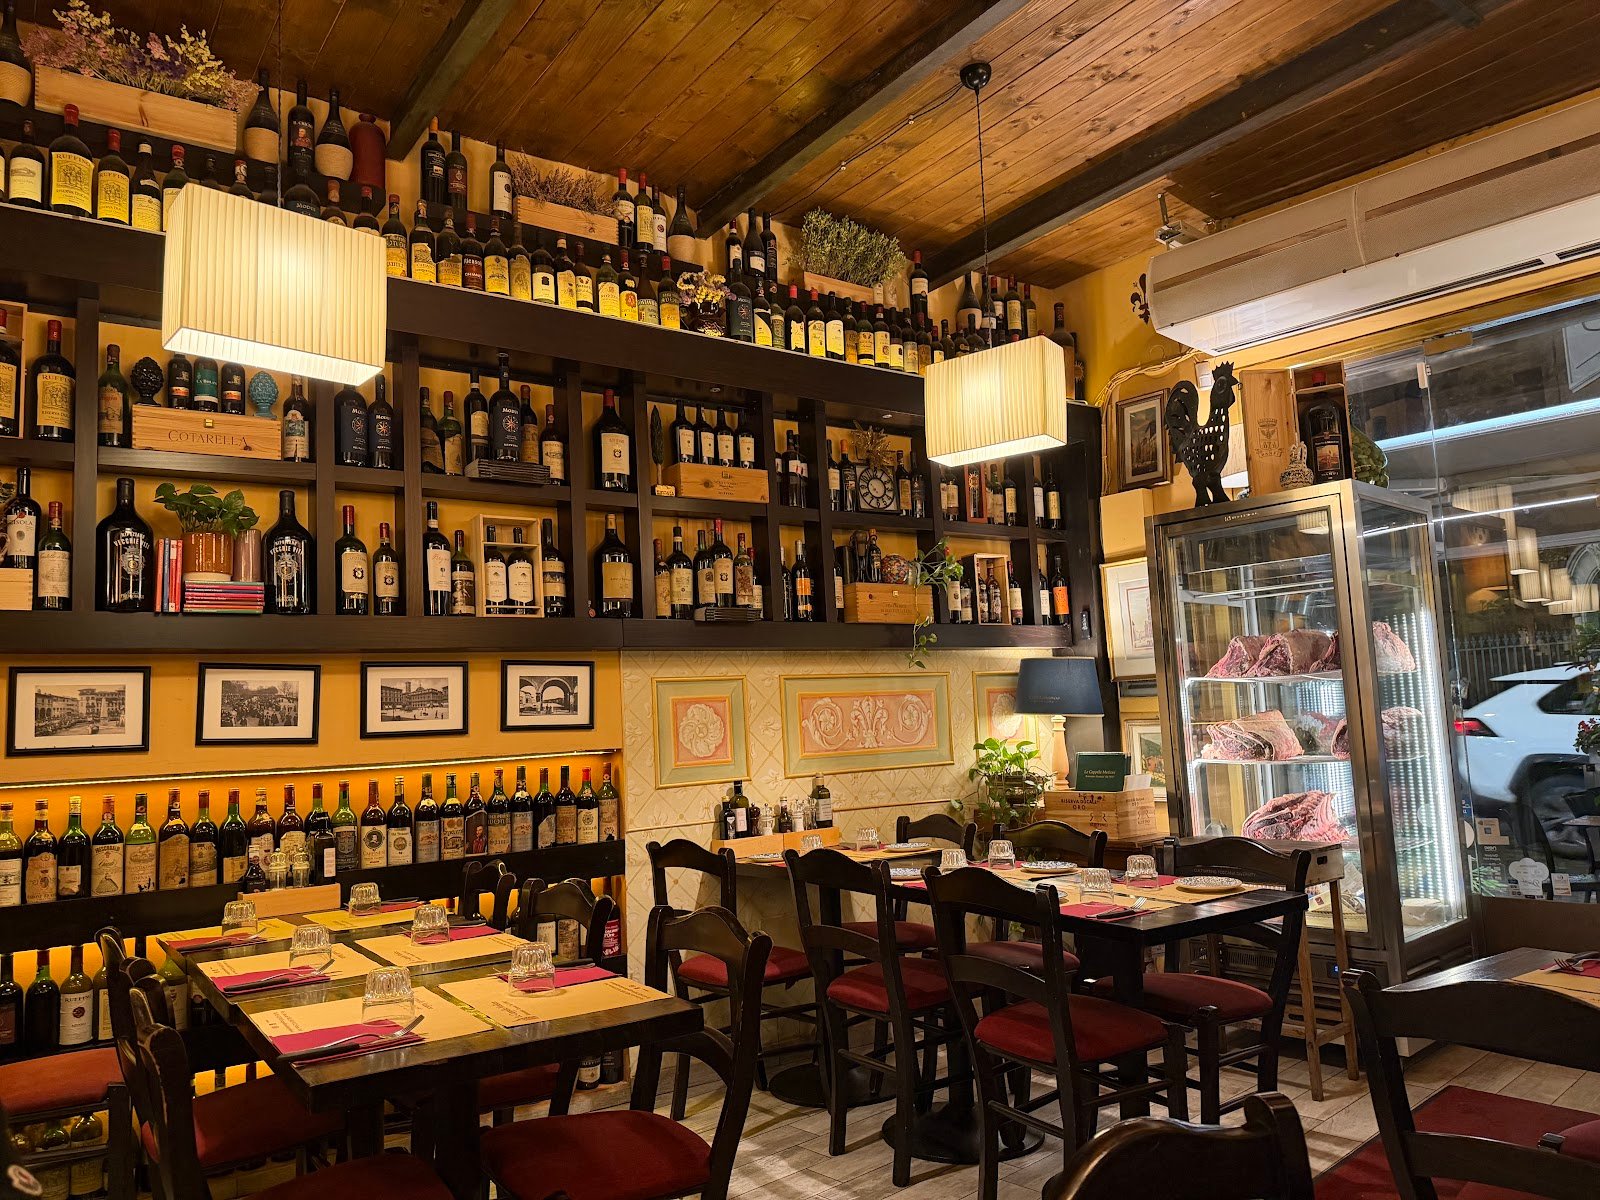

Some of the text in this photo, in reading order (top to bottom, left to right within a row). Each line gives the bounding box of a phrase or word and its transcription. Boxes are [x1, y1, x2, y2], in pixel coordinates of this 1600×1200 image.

[56, 153, 91, 167] RUFFINO
[168, 429, 249, 447] COTARELLA
[114, 537, 139, 547] VECCHIE
